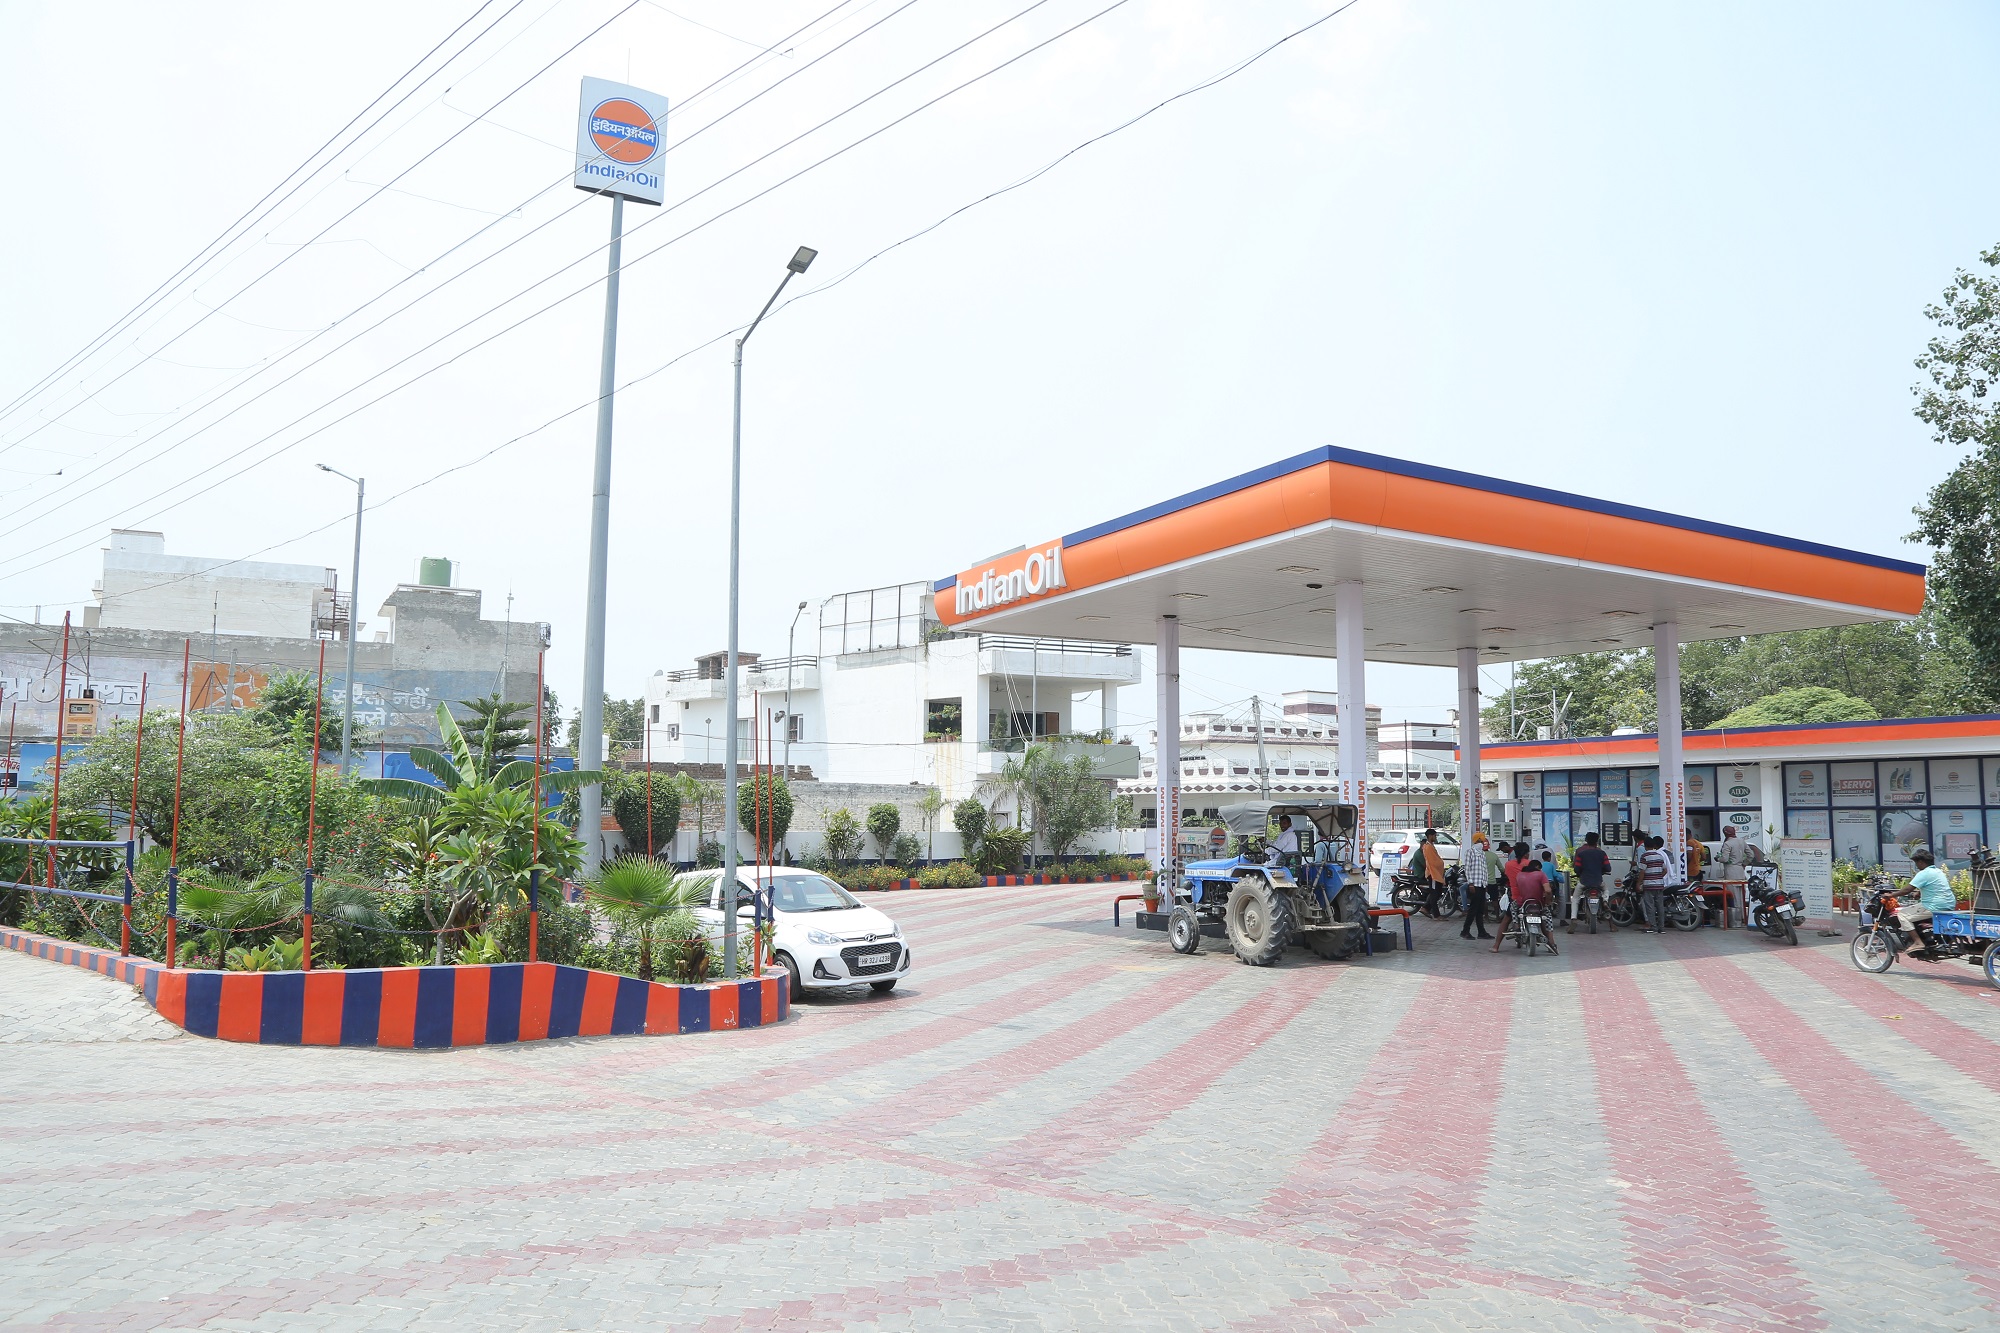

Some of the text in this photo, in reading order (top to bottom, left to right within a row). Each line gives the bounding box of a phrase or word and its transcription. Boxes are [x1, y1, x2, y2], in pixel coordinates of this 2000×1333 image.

[584, 161, 658, 189] IndianOil
[955, 545, 1067, 616] IndianOil
[1841, 780, 1873, 789] SERVO
